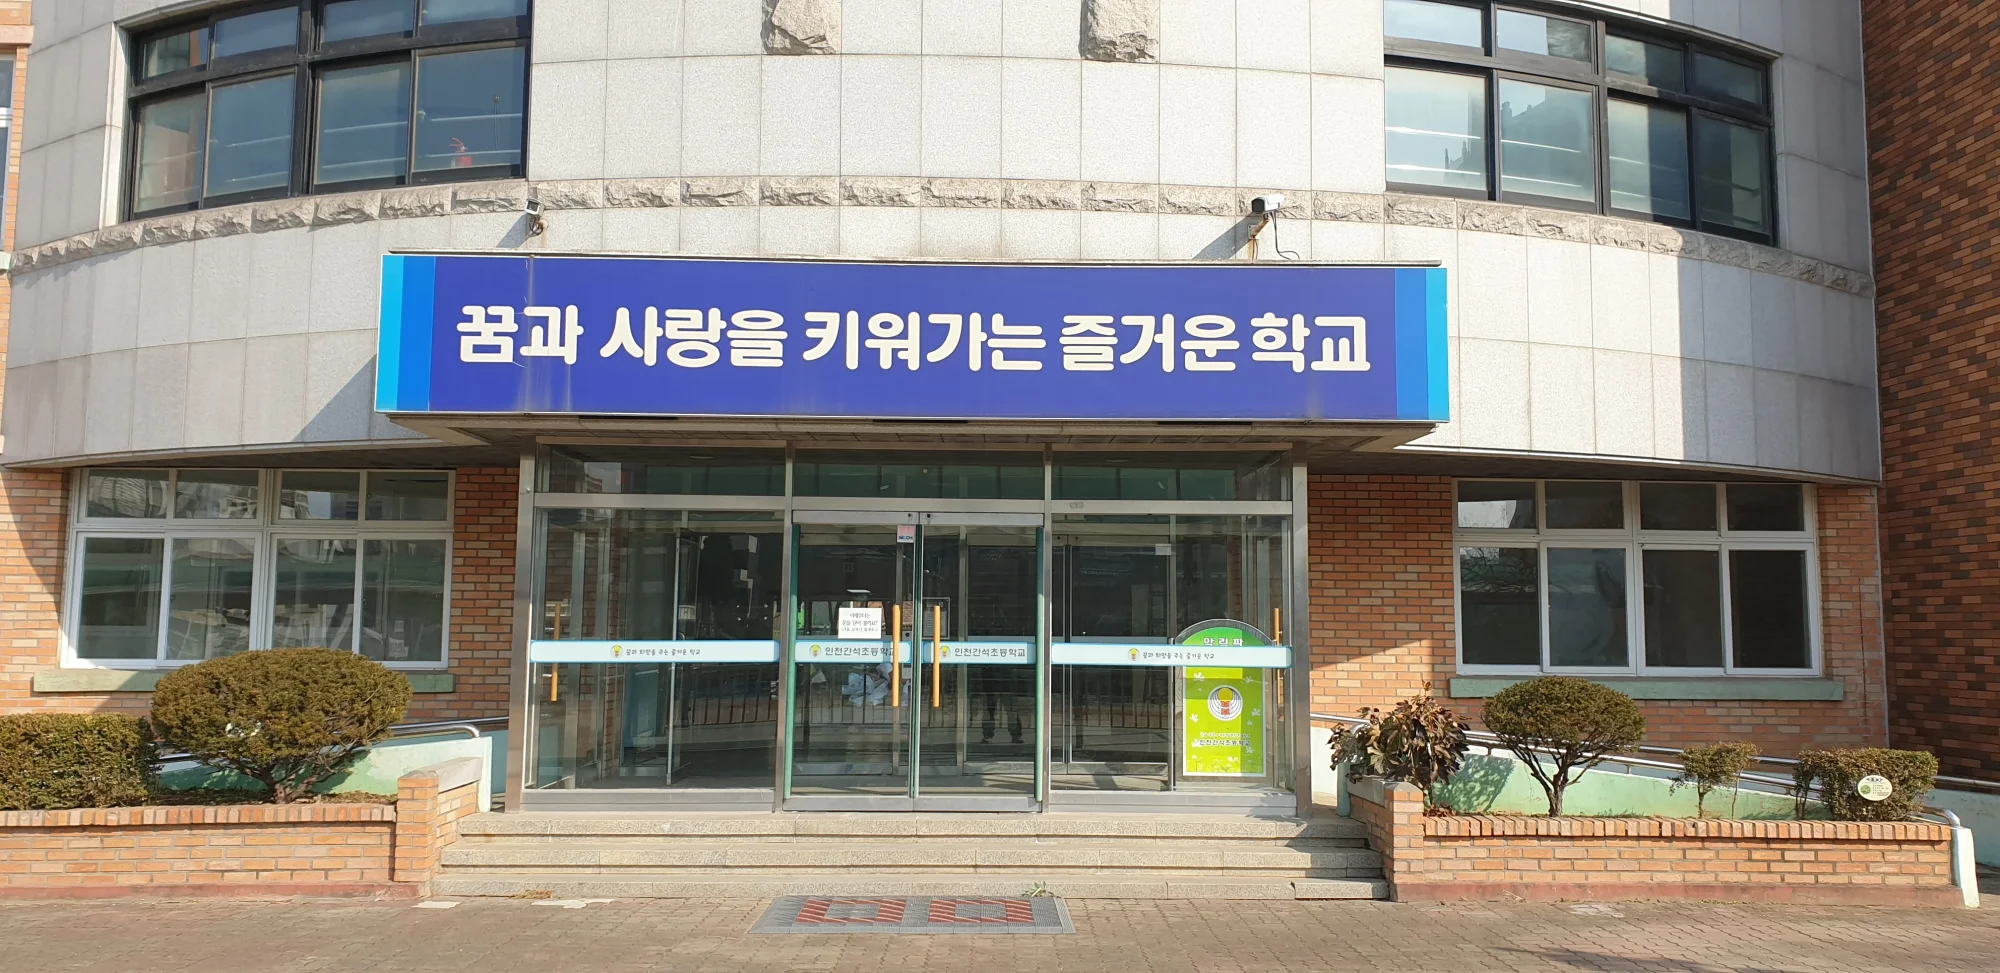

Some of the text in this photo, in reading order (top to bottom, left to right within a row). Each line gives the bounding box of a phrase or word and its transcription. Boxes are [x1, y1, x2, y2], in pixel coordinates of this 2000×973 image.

[457, 304, 1371, 373] 꿈과 사랑을 키워가는 즐거운 학교
[954, 647, 1026, 658] 인천간석초등학교
[1173, 652, 1184, 660] 주는
[1186, 652, 1202, 660] 즐거운
[1203, 652, 1215, 660] 학교
